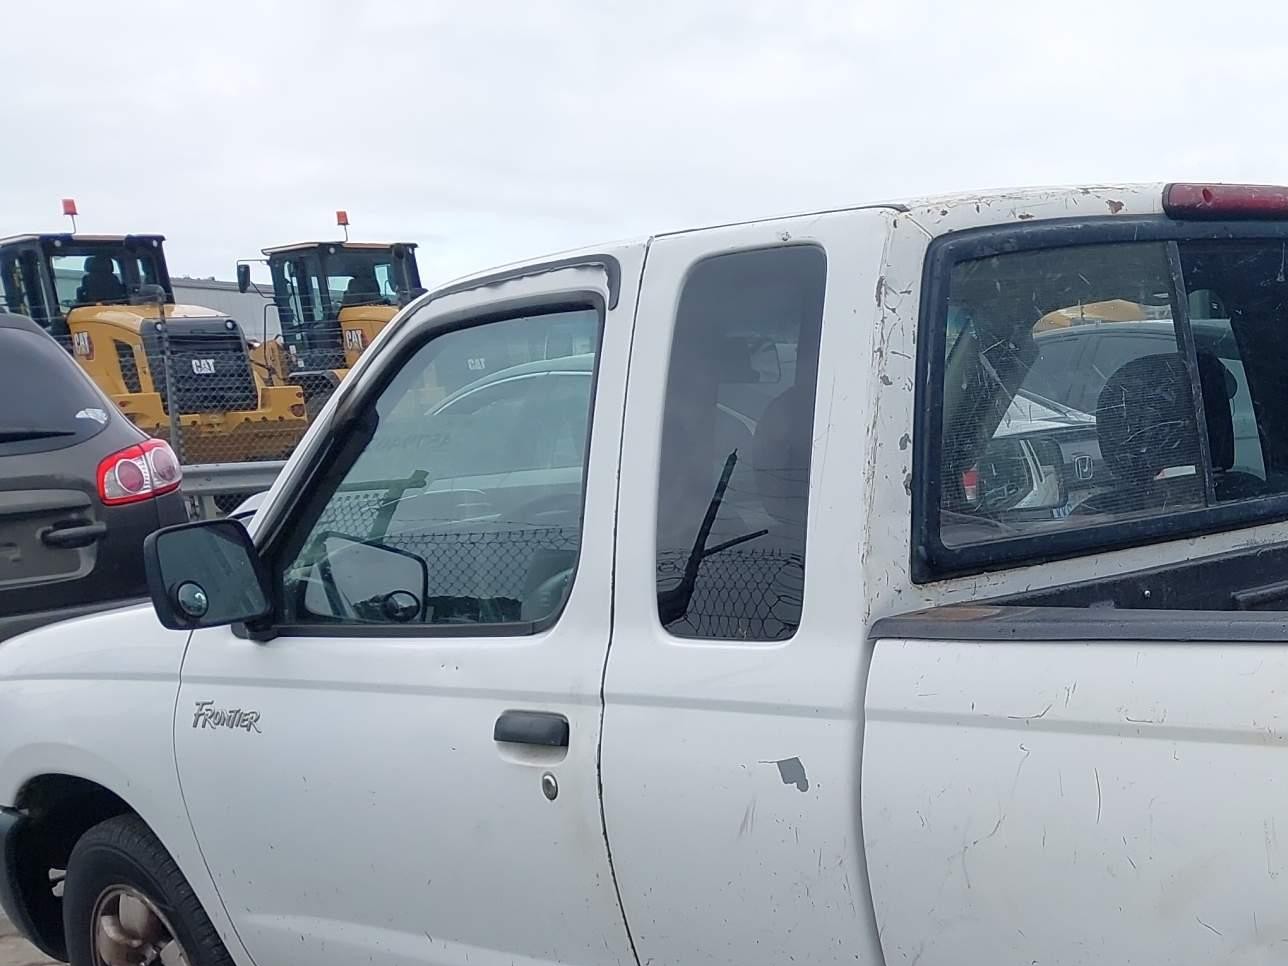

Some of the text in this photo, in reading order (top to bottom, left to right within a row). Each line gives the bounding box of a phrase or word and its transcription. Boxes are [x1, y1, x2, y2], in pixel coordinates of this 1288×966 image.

[74, 331, 91, 355] CAT
[192, 358, 216, 374] CAT
[467, 358, 486, 370] CAT
